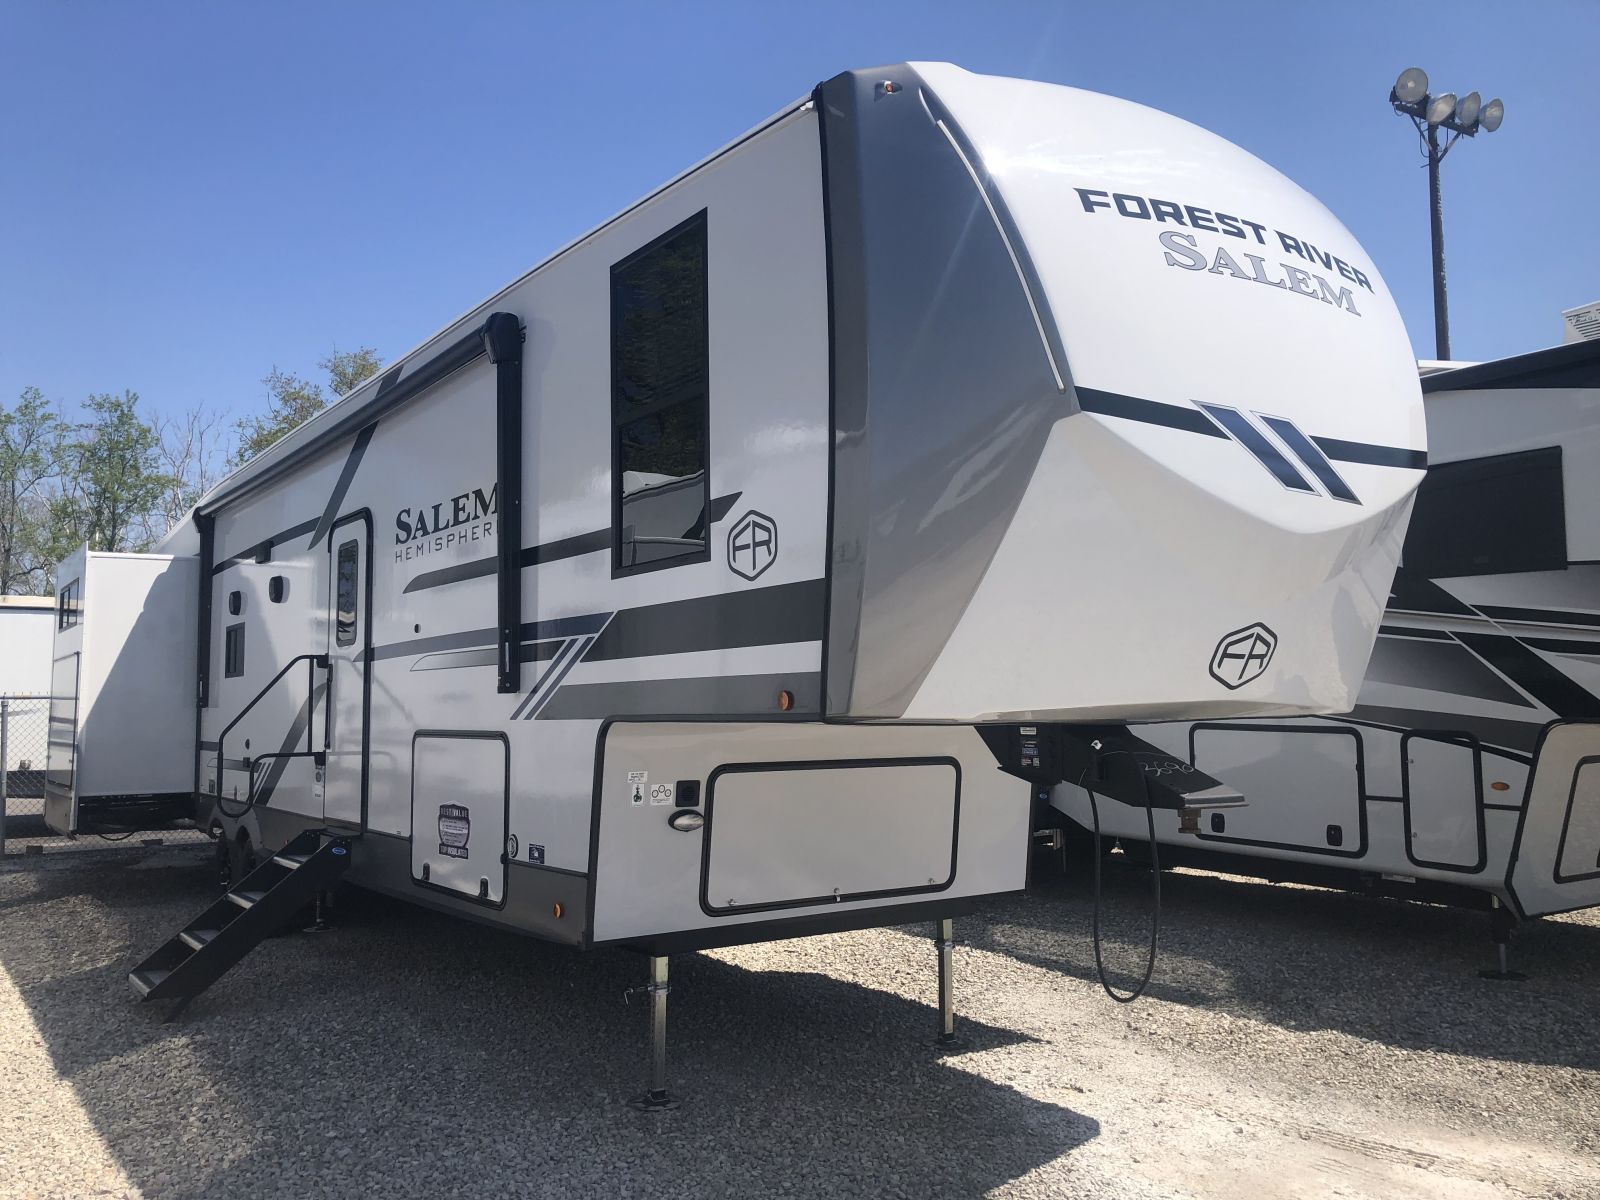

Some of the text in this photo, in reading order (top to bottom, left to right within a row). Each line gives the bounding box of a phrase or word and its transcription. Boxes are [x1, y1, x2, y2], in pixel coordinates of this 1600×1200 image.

[1072, 187, 1376, 295] FOREST RIVER
[1159, 231, 1362, 317] SALEM
[395, 482, 499, 546] SALEM
[395, 522, 499, 564] HEMISPHER
